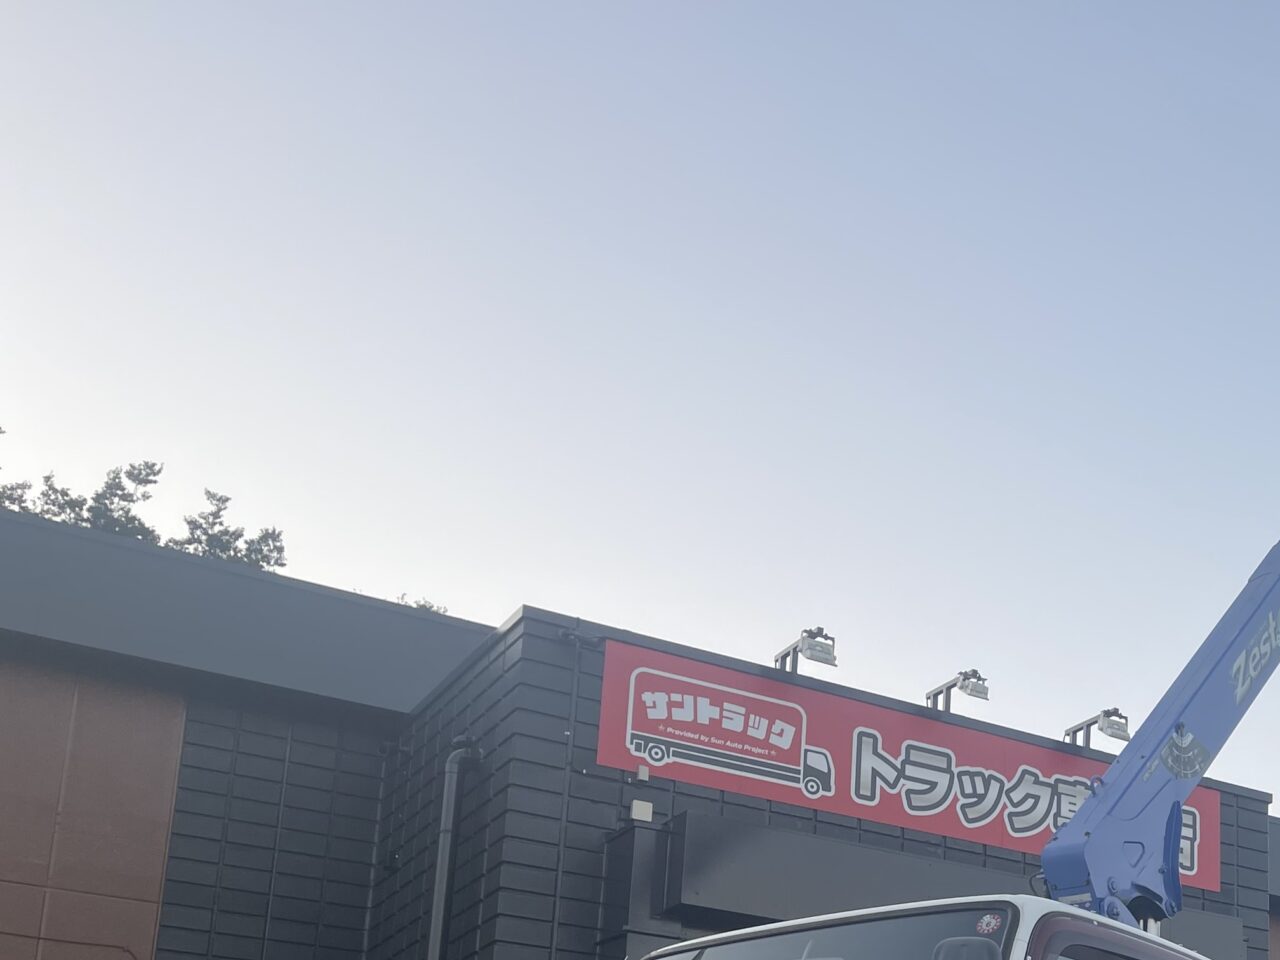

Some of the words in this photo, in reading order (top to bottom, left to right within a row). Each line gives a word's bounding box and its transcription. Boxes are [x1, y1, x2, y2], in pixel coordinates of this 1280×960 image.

[641, 691, 796, 749] サントラック
[667, 726, 699, 740] Provided
[700, 734, 710, 743] by
[710, 736, 725, 746] Sun
[725, 740, 743, 750] Auto
[743, 744, 769, 755] Project
